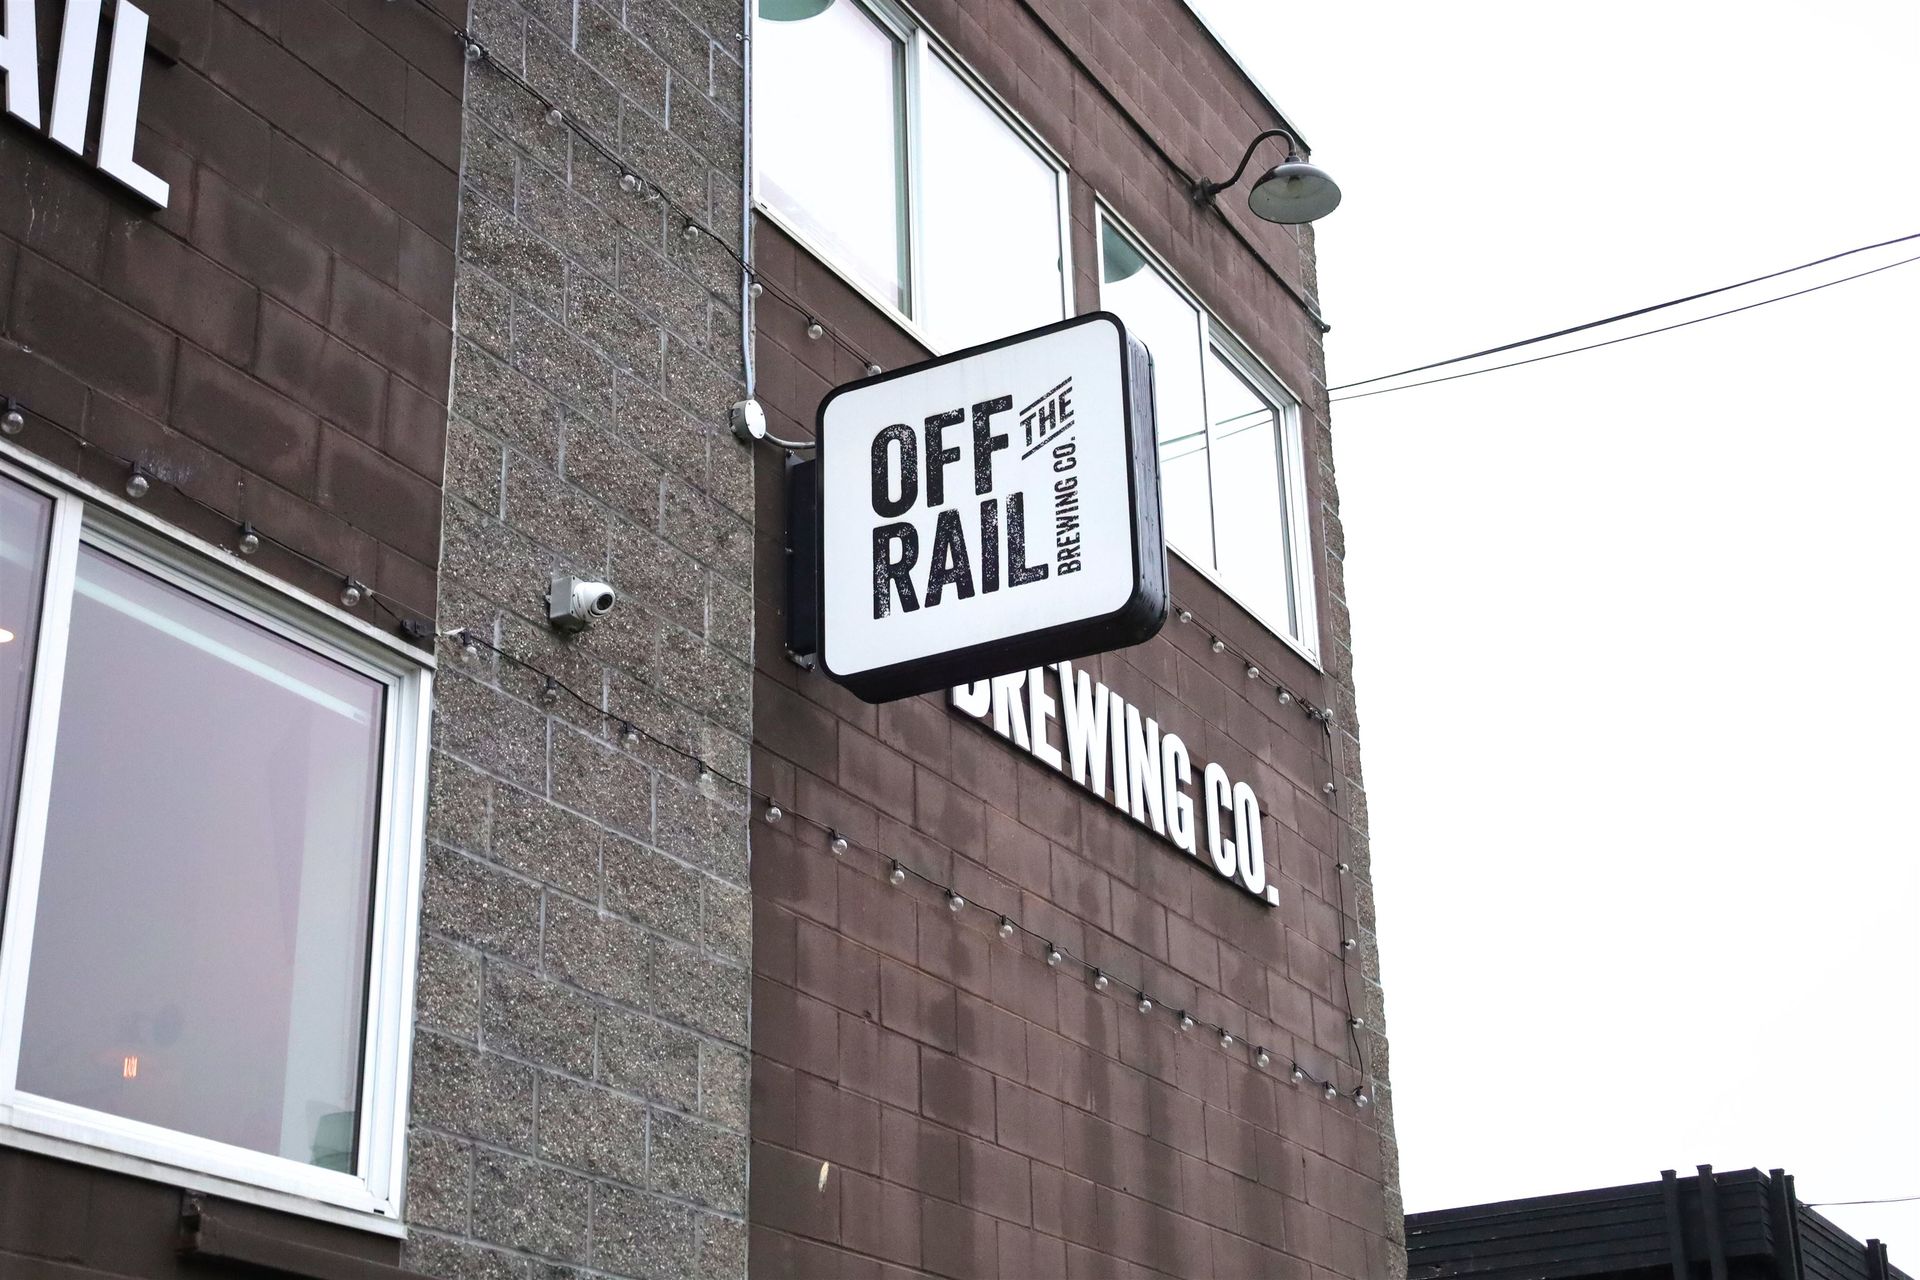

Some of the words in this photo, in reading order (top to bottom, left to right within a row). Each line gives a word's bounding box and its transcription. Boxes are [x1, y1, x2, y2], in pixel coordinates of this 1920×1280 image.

[871, 394, 1014, 519] OFF
[1019, 386, 1075, 447] THE
[1052, 436, 1078, 473] CO.
[872, 491, 1049, 620] RAIL
[1054, 476, 1082, 576] BREWING
[1204, 762, 1280, 907] CO.
